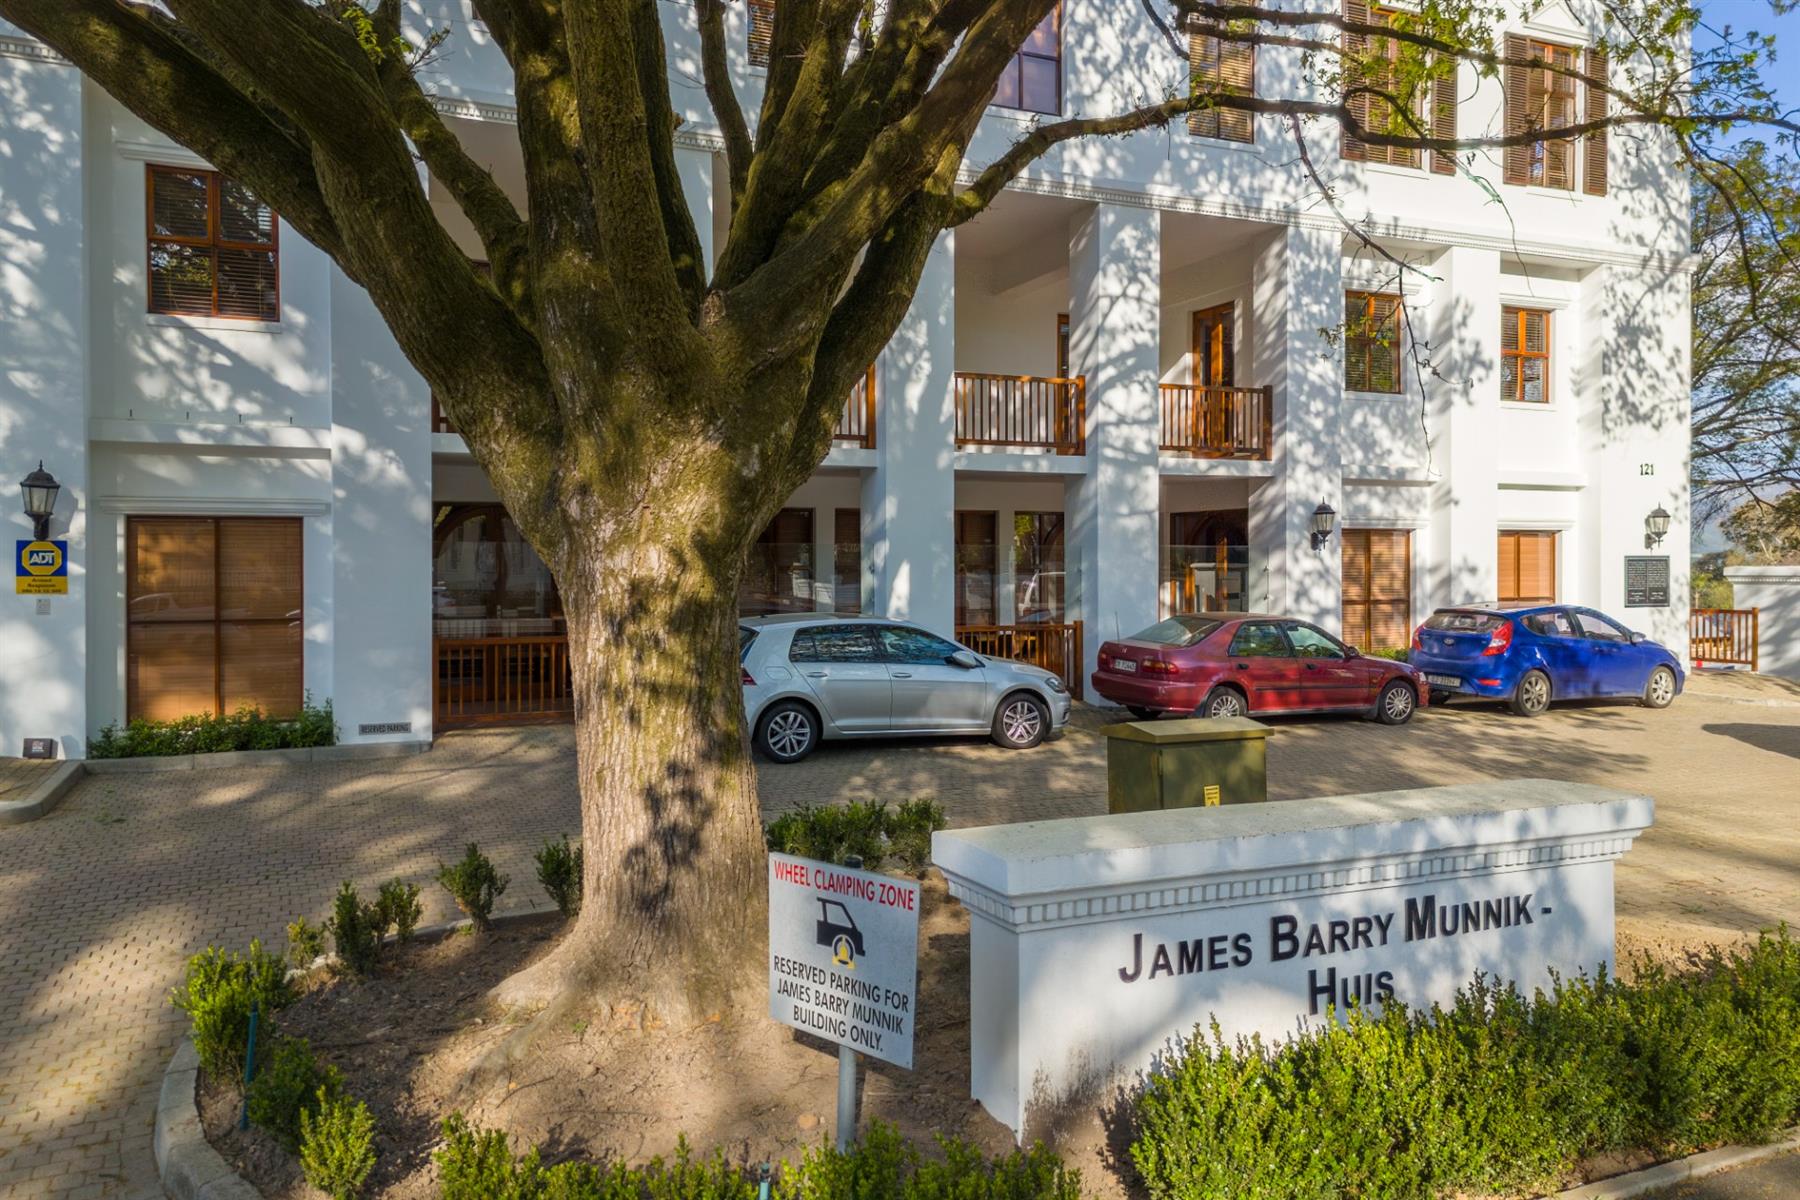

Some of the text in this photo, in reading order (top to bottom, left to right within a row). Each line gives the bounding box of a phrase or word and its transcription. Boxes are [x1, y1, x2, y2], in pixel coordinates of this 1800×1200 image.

[1640, 463, 1654, 476] 121
[30, 552, 55, 564] ADT
[361, 722, 409, 734] RESERVED PARKING
[774, 860, 914, 911] WHEEL CLAMPING ZONE
[1118, 933, 1252, 984] JAMES
[1271, 914, 1394, 962] BARRY
[774, 955, 909, 1013] RESERVED PARKING FOR
[777, 978, 903, 1035] JAMES BARRY MUNNIK
[1308, 967, 1394, 1016] HUIS
[793, 1005, 883, 1052] BUILDING ONLY.
